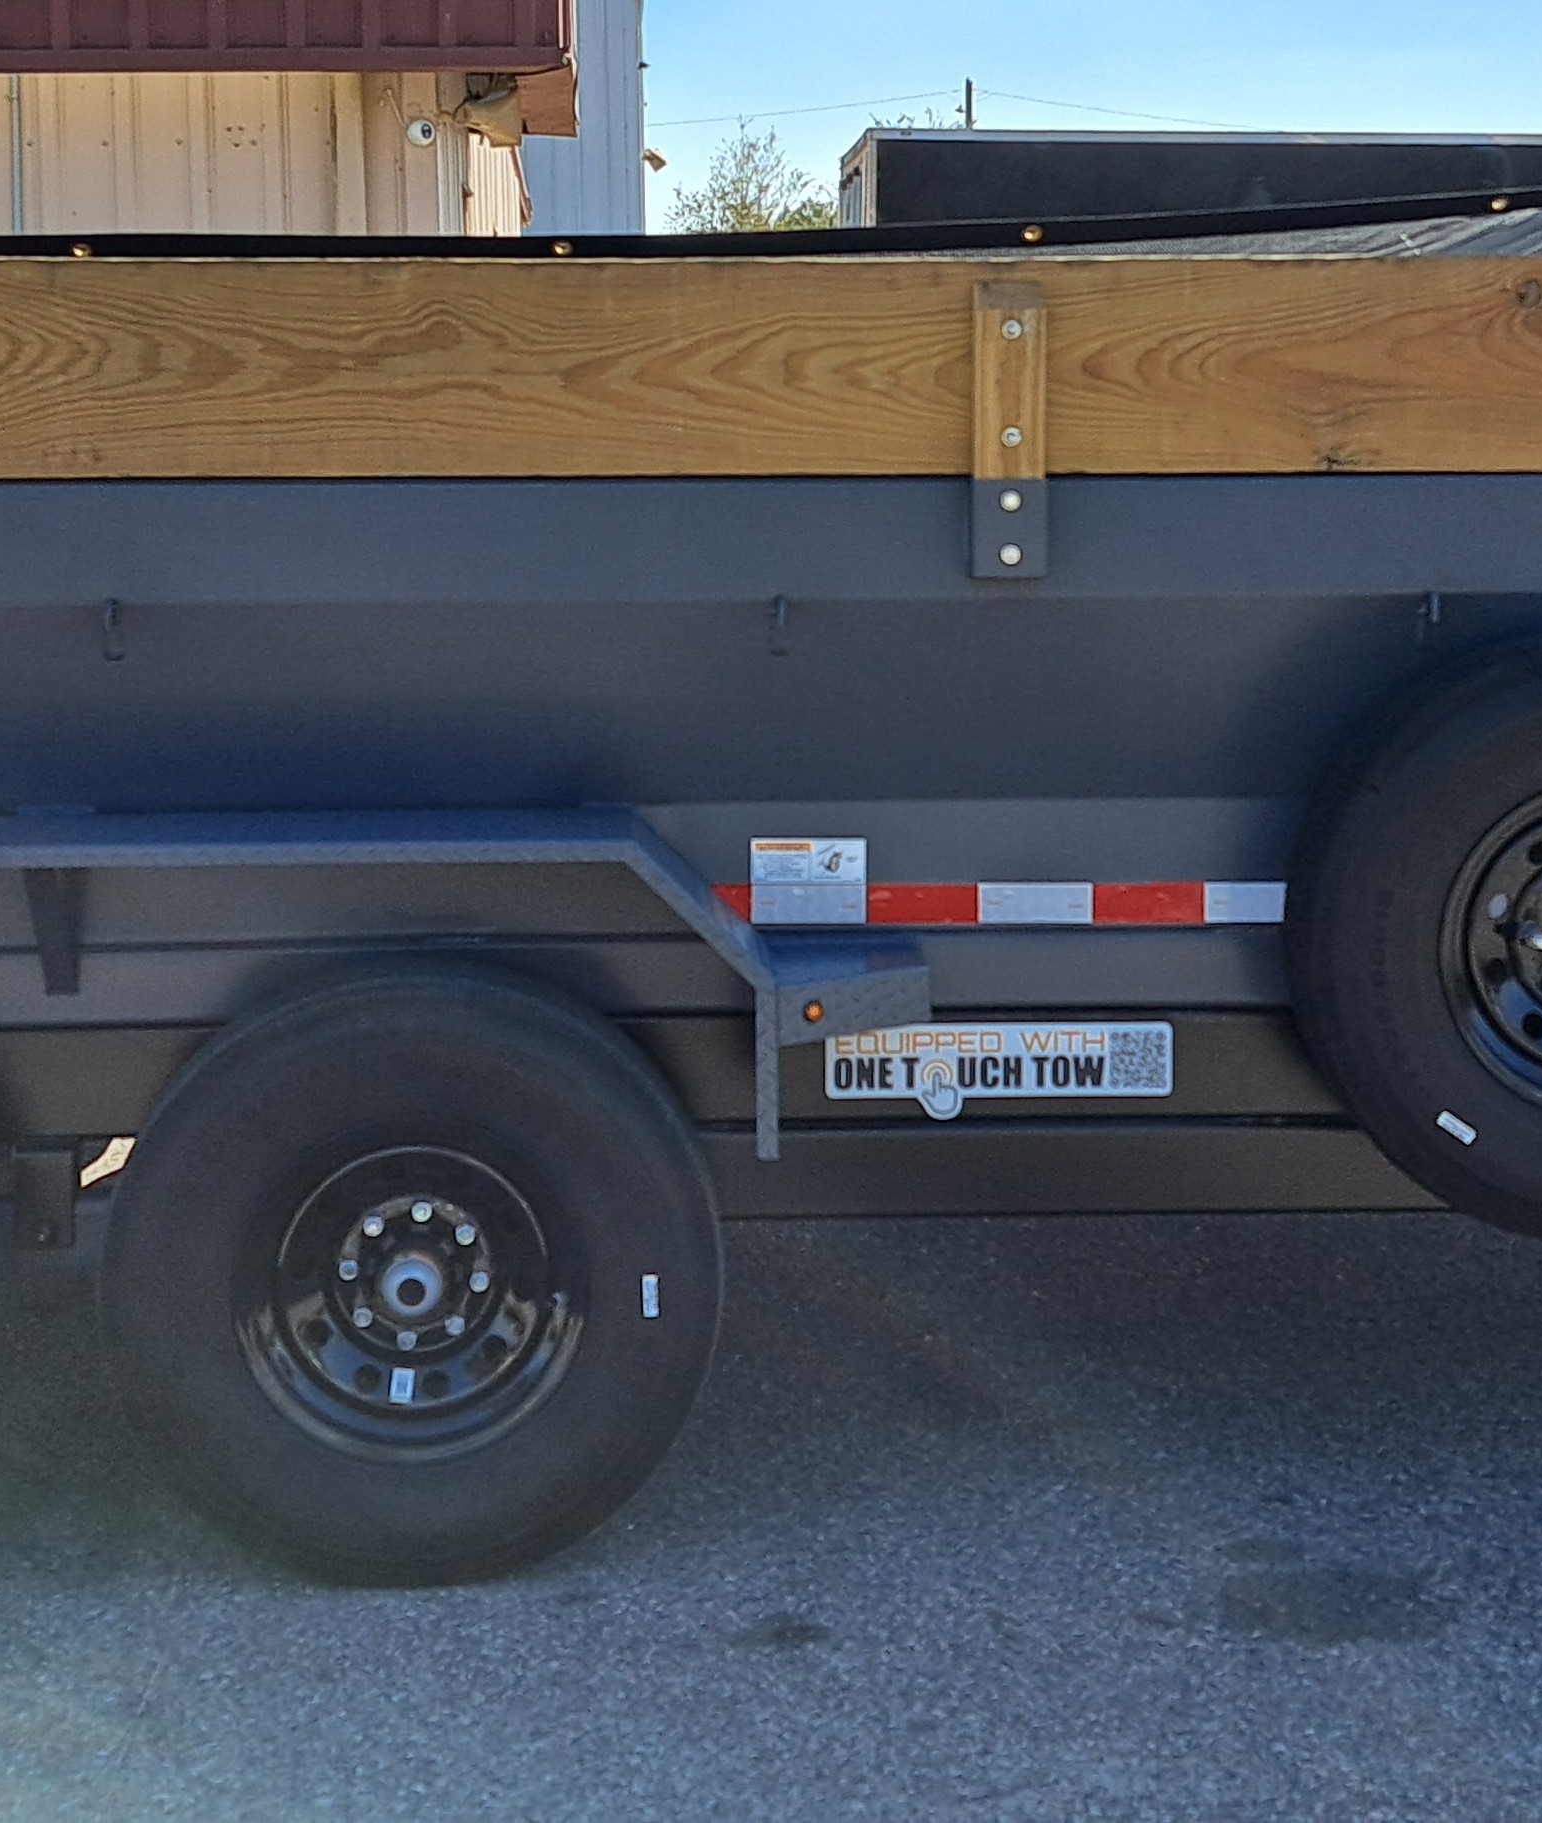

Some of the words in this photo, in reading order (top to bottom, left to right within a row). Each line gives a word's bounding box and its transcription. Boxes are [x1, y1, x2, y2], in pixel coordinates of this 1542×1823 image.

[835, 1031, 1002, 1055] EQUIPPED
[1020, 1031, 1106, 1053] WITH
[834, 1057, 894, 1089] ONE
[1032, 1056, 1106, 1089] TOW
